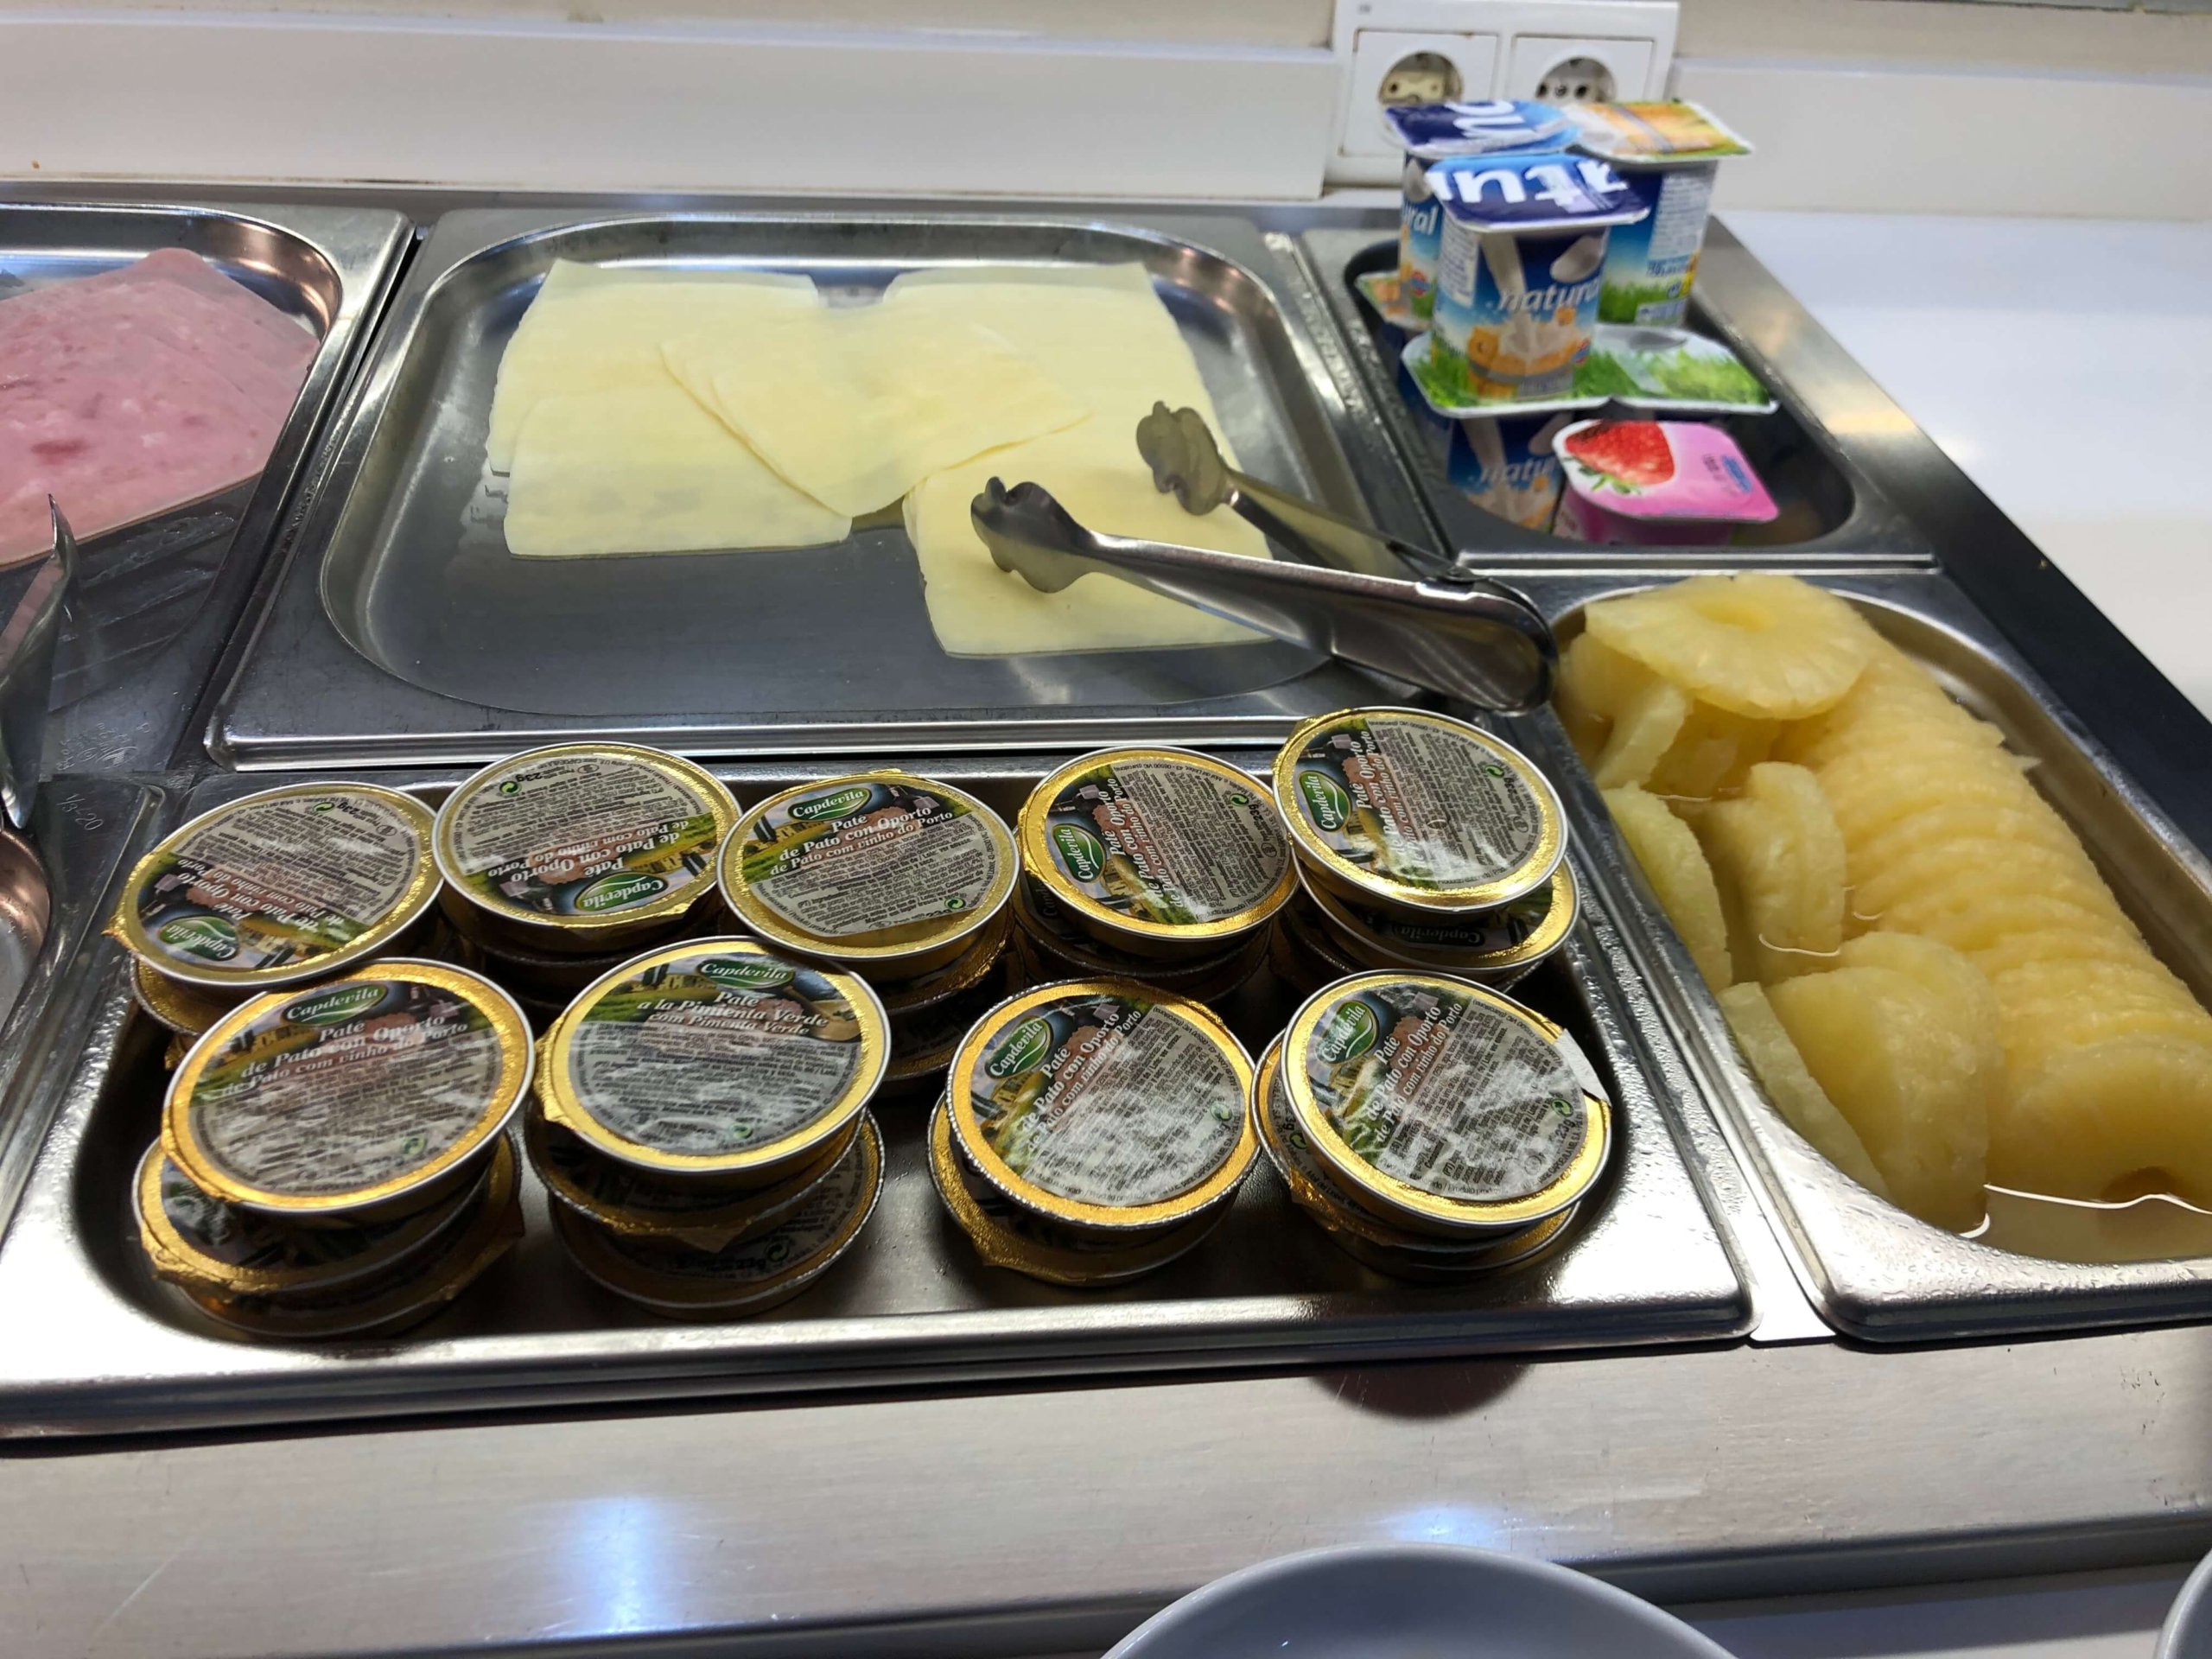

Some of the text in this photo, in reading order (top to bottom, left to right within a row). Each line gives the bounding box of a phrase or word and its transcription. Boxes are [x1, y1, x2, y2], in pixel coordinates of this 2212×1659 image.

[1361, 731, 1379, 757] Porto
[1350, 741, 1376, 779] Oporto
[1372, 759, 1385, 771] do
[515, 771, 542, 783] 23g
[792, 790, 864, 817] Capdevila
[1108, 779, 1127, 803] Porto
[1305, 775, 1337, 829] Capdevila
[336, 802, 364, 821] 23g
[1122, 804, 1135, 815] do
[637, 823, 673, 836] Pato
[671, 820, 690, 830] de
[779, 807, 931, 861] de Pato con Oporto
[604, 833, 632, 844] com
[770, 811, 953, 876] de Pato com vinho do Porto
[1098, 791, 1164, 898] de Pato con Oporto
[487, 857, 530, 877] Porto
[511, 832, 680, 883] de Pato con Oporto
[535, 851, 554, 862] do
[1058, 828, 1093, 880] Capdevila
[1145, 845, 1162, 866] com
[178, 859, 208, 876] Porto
[213, 868, 232, 882] do
[1157, 868, 1175, 892] Pato
[177, 872, 318, 933] de Pato con Oporto
[267, 890, 296, 904] com
[582, 880, 664, 908] Capdevila
[1169, 893, 1184, 908] de
[295, 901, 326, 918] Pato
[327, 912, 345, 926] de
[166, 925, 236, 958] Capdevila
[701, 962, 787, 981] Capdevila
[287, 987, 379, 1020] Capdevila
[637, 999, 830, 1027] a la Pimienta Verde
[649, 1012, 810, 1036] com Pimenta Verde
[1322, 1005, 1366, 1062] Capdevila
[295, 1058, 334, 1073] com
[339, 1044, 387, 1063] vinho
[989, 1022, 1043, 1076] Capdevila
[1033, 1081, 1065, 1111] Pato
[1063, 1056, 1086, 1080] con
[1080, 1013, 1120, 1053] Oporto
[1061, 1083, 1084, 1106] com
[1082, 1053, 1108, 1081] vinho
[1105, 1037, 1119, 1052] do
[1115, 1010, 1141, 1036] Porto
[241, 1062, 267, 1078] de
[274, 1047, 322, 1068] Pato
[1367, 1007, 1441, 1121] de Pato con Oporto
[1375, 1002, 1463, 1142] de Pato com vinho do Porto
[1555, 1118, 1575, 1139] 23g
